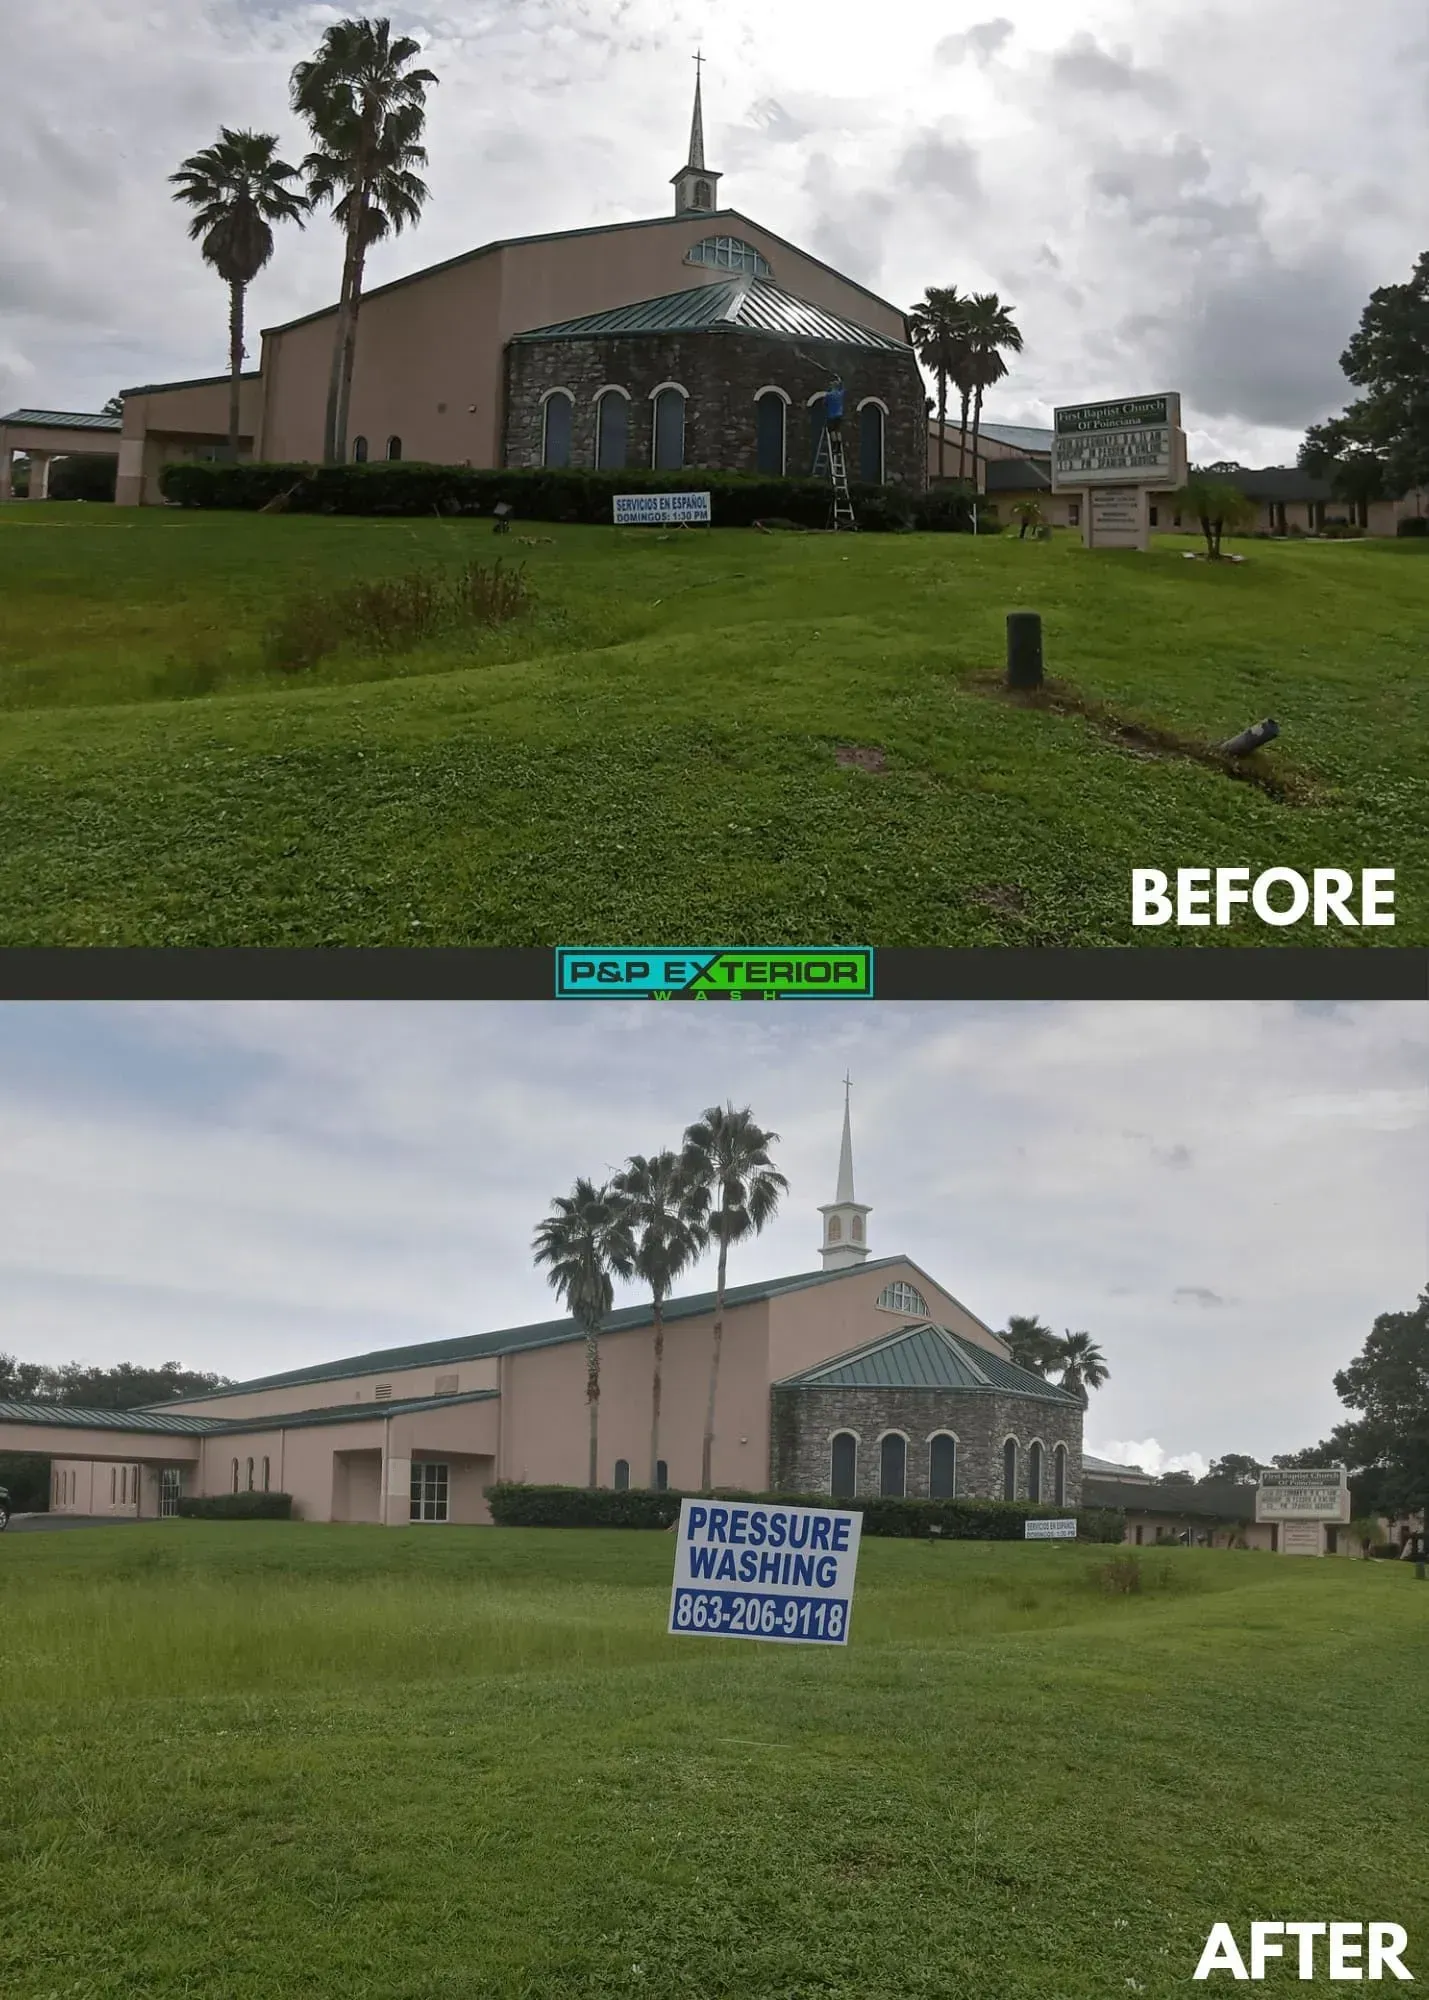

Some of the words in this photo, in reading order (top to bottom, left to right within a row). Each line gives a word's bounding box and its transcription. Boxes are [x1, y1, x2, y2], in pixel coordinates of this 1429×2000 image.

[1059, 411, 1080, 421] First
[1084, 407, 1119, 419] Baptist
[1123, 400, 1164, 413] Church
[1078, 421, 1091, 430] Of
[1094, 418, 1142, 428] Poinciana
[616, 497, 658, 511] SERVICIOS
[659, 497, 670, 509] EN
[672, 494, 707, 509] ESPAÑOL
[673, 511, 692, 520] 1:30
[694, 510, 708, 520] PM
[687, 1506, 852, 1552] PRESSURE
[689, 1546, 838, 1588] WASHING
[676, 1593, 843, 1638] 863-206-9118
